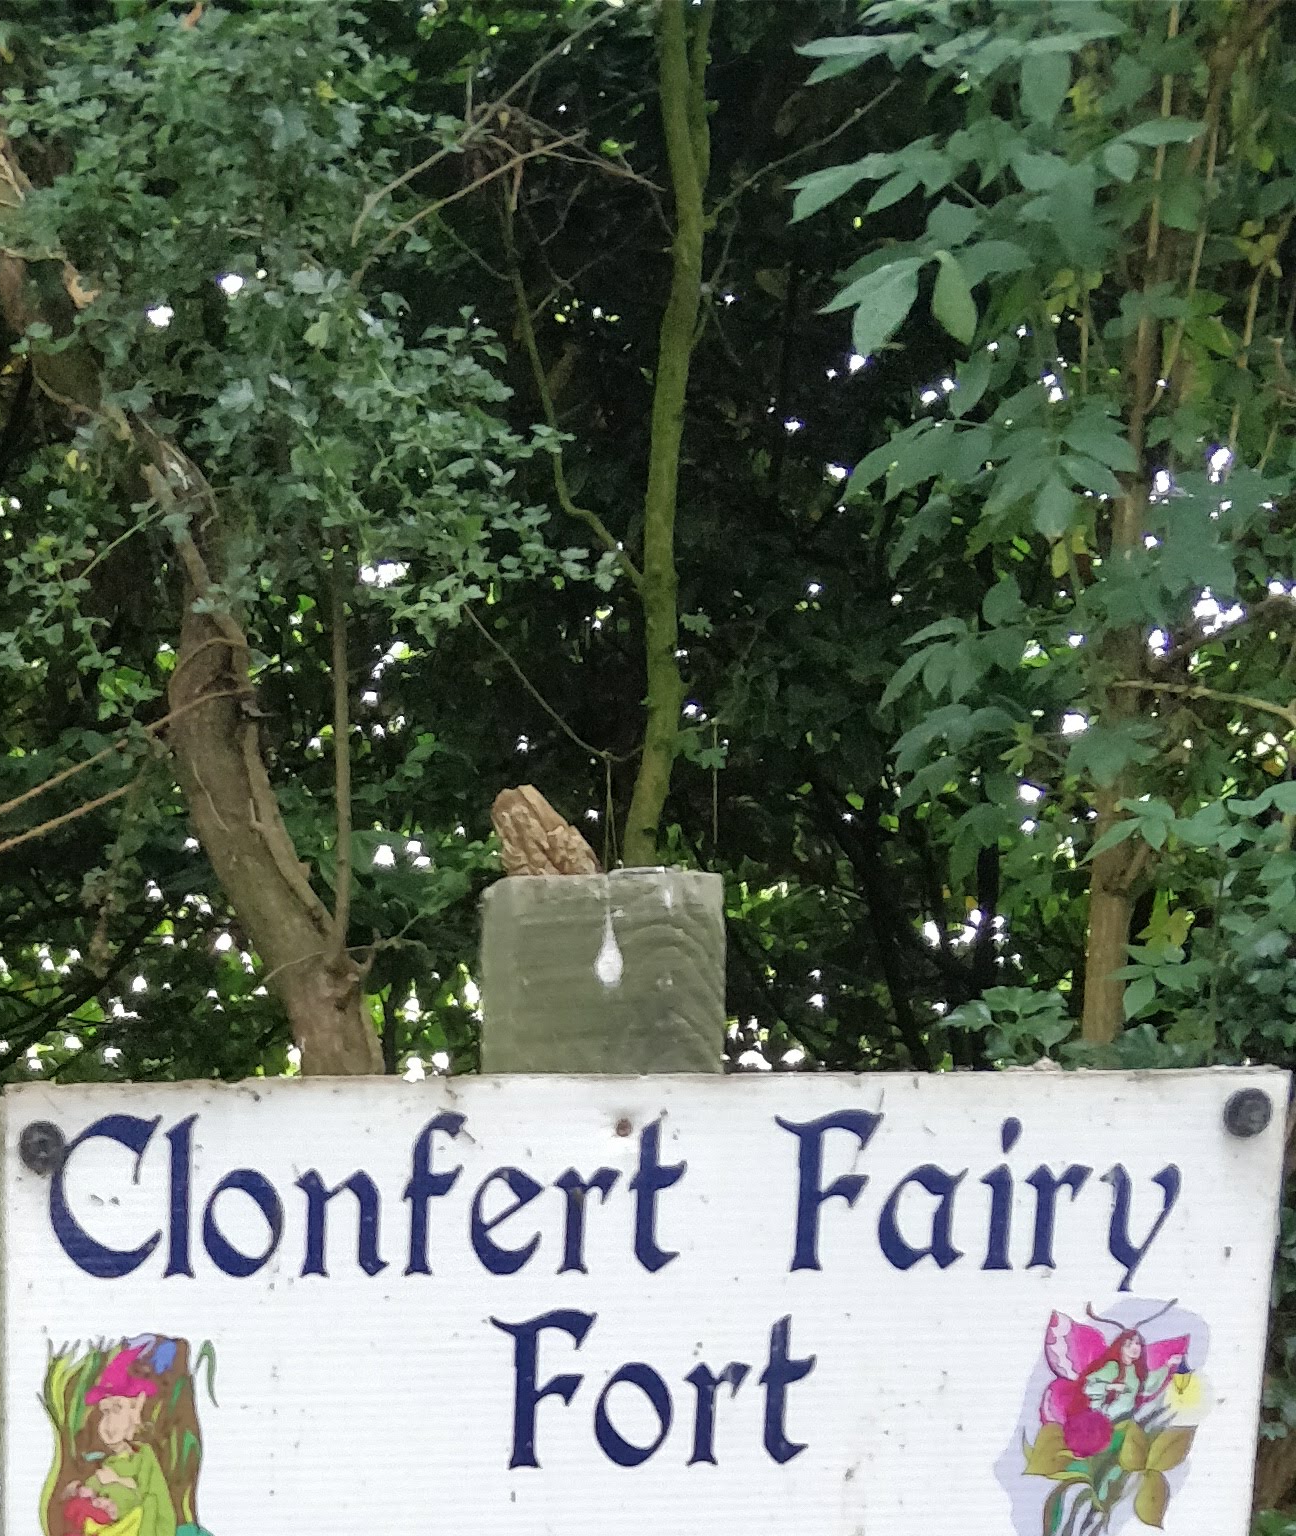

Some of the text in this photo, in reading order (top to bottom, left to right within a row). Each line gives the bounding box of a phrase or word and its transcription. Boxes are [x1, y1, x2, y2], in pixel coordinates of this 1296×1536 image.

[48, 1108, 1183, 1293] Clonfert Fairy
[488, 1308, 818, 1471] Fort
